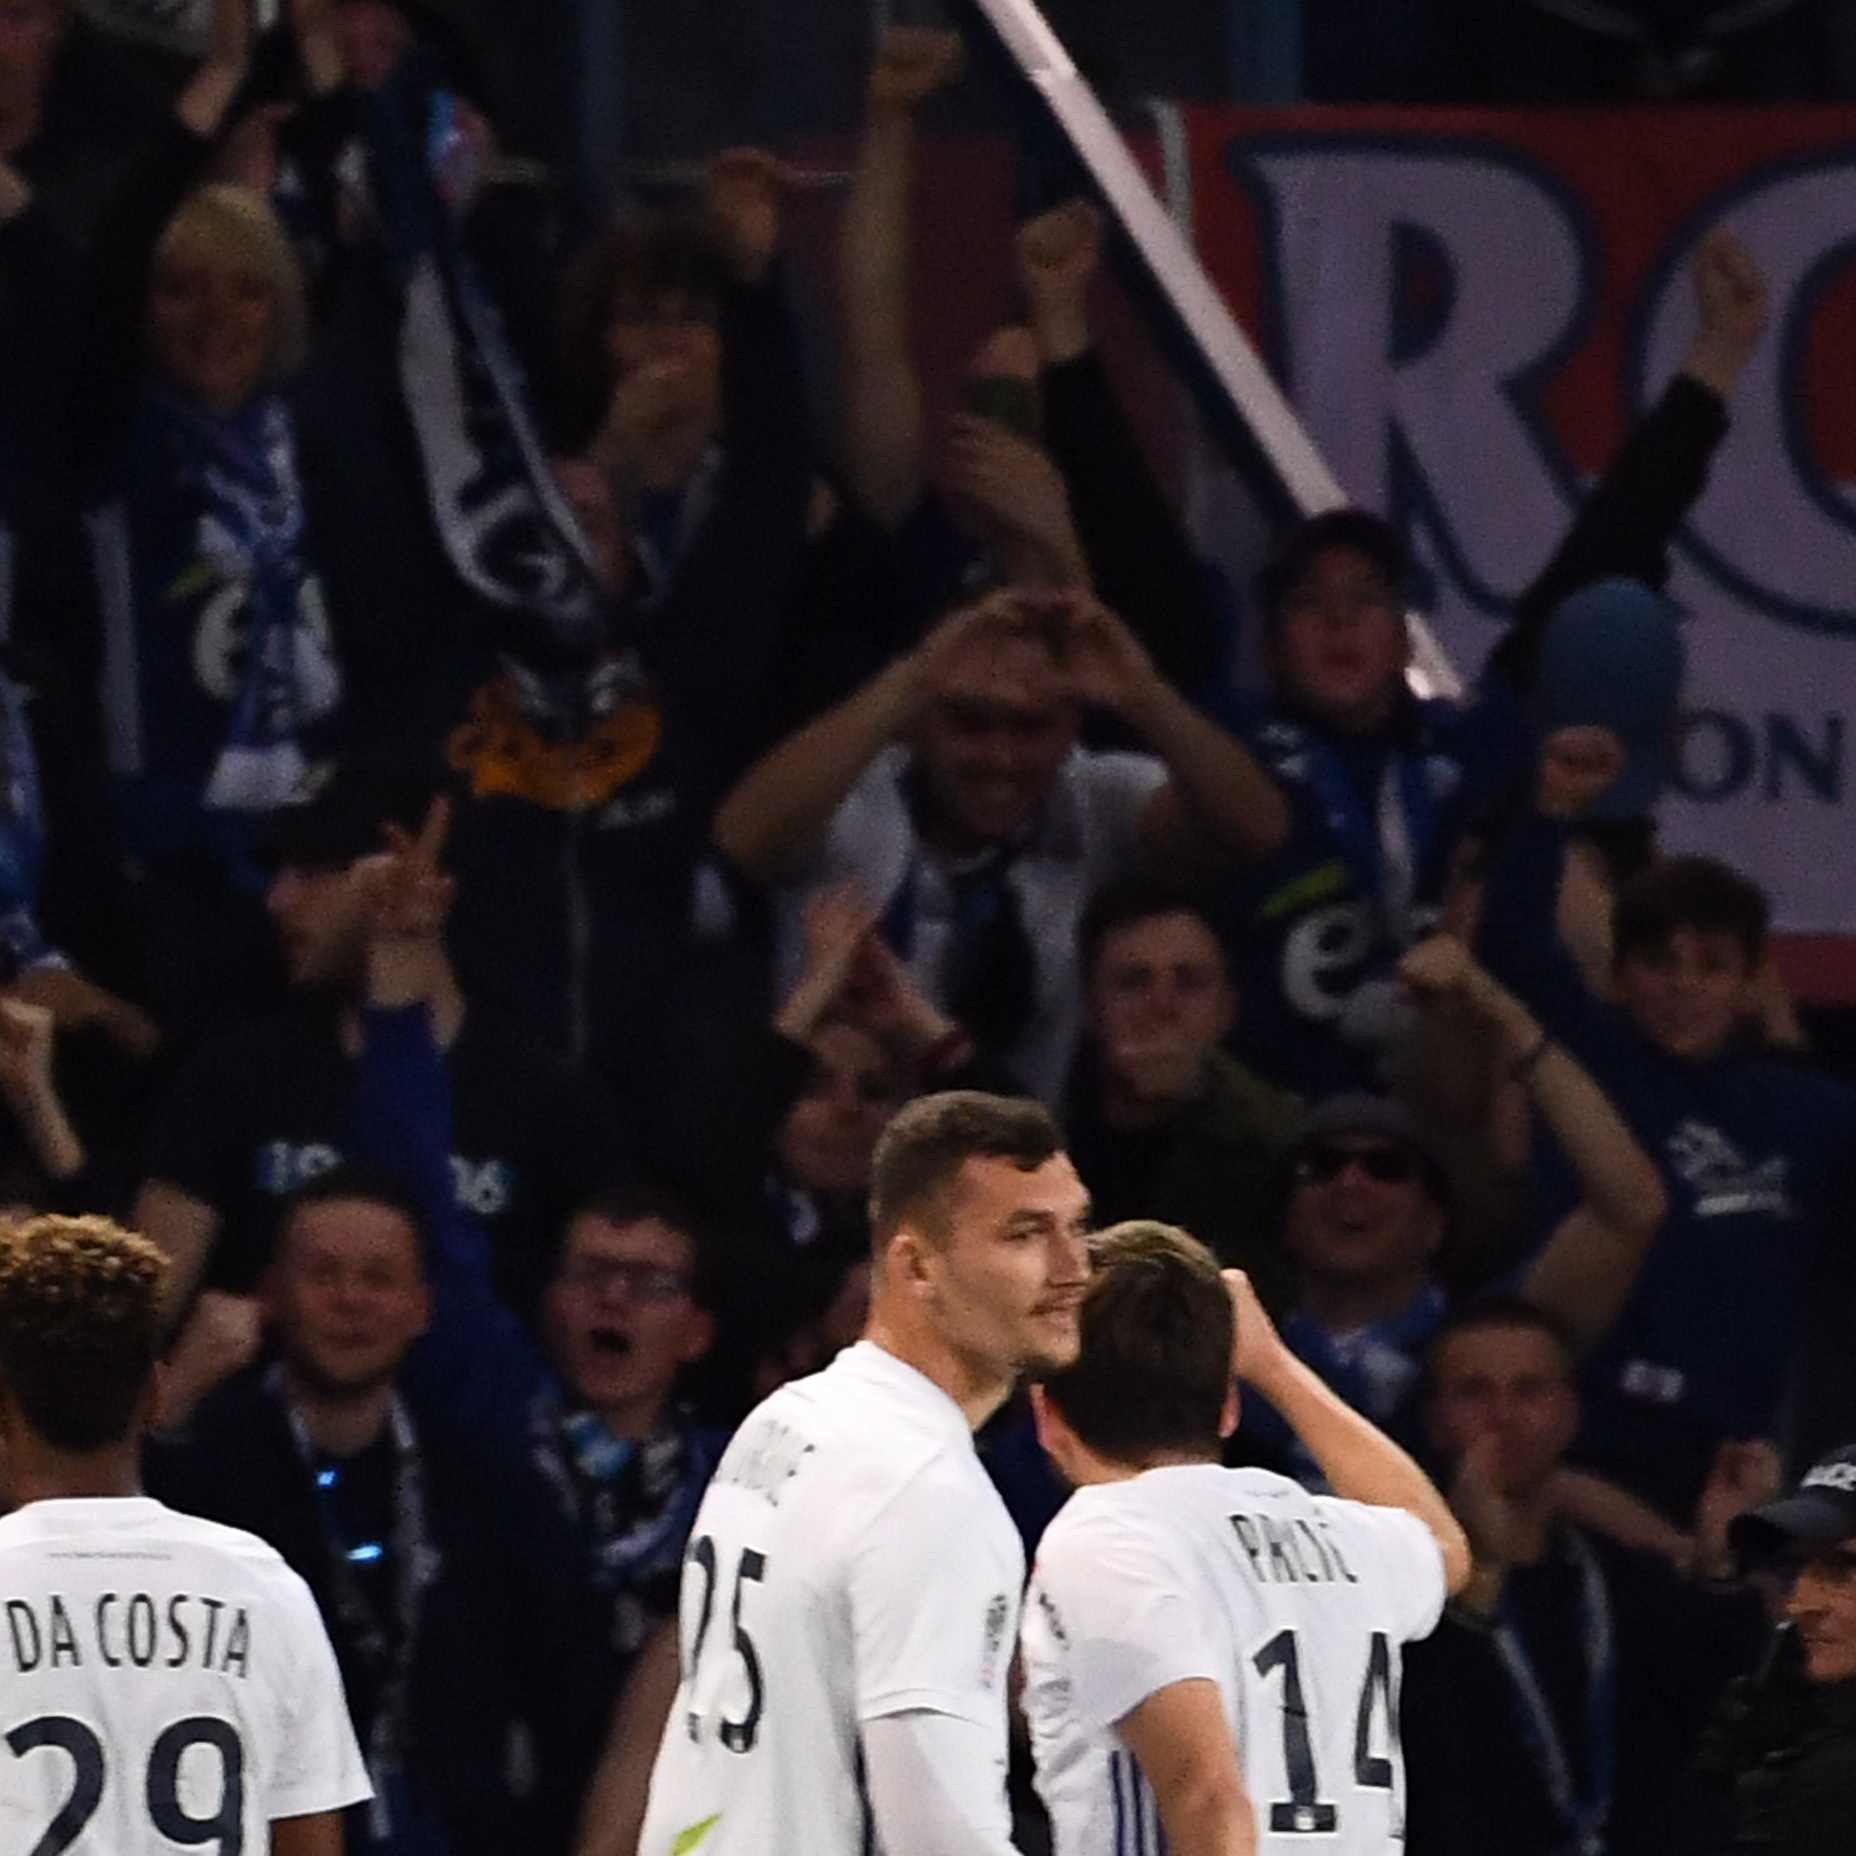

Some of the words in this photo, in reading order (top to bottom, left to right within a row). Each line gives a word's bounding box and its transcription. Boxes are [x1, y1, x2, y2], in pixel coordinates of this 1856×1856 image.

[6, 1598, 79, 1673] DA
[97, 1595, 250, 1678] COSTA
[1252, 1630, 1396, 1833] 14
